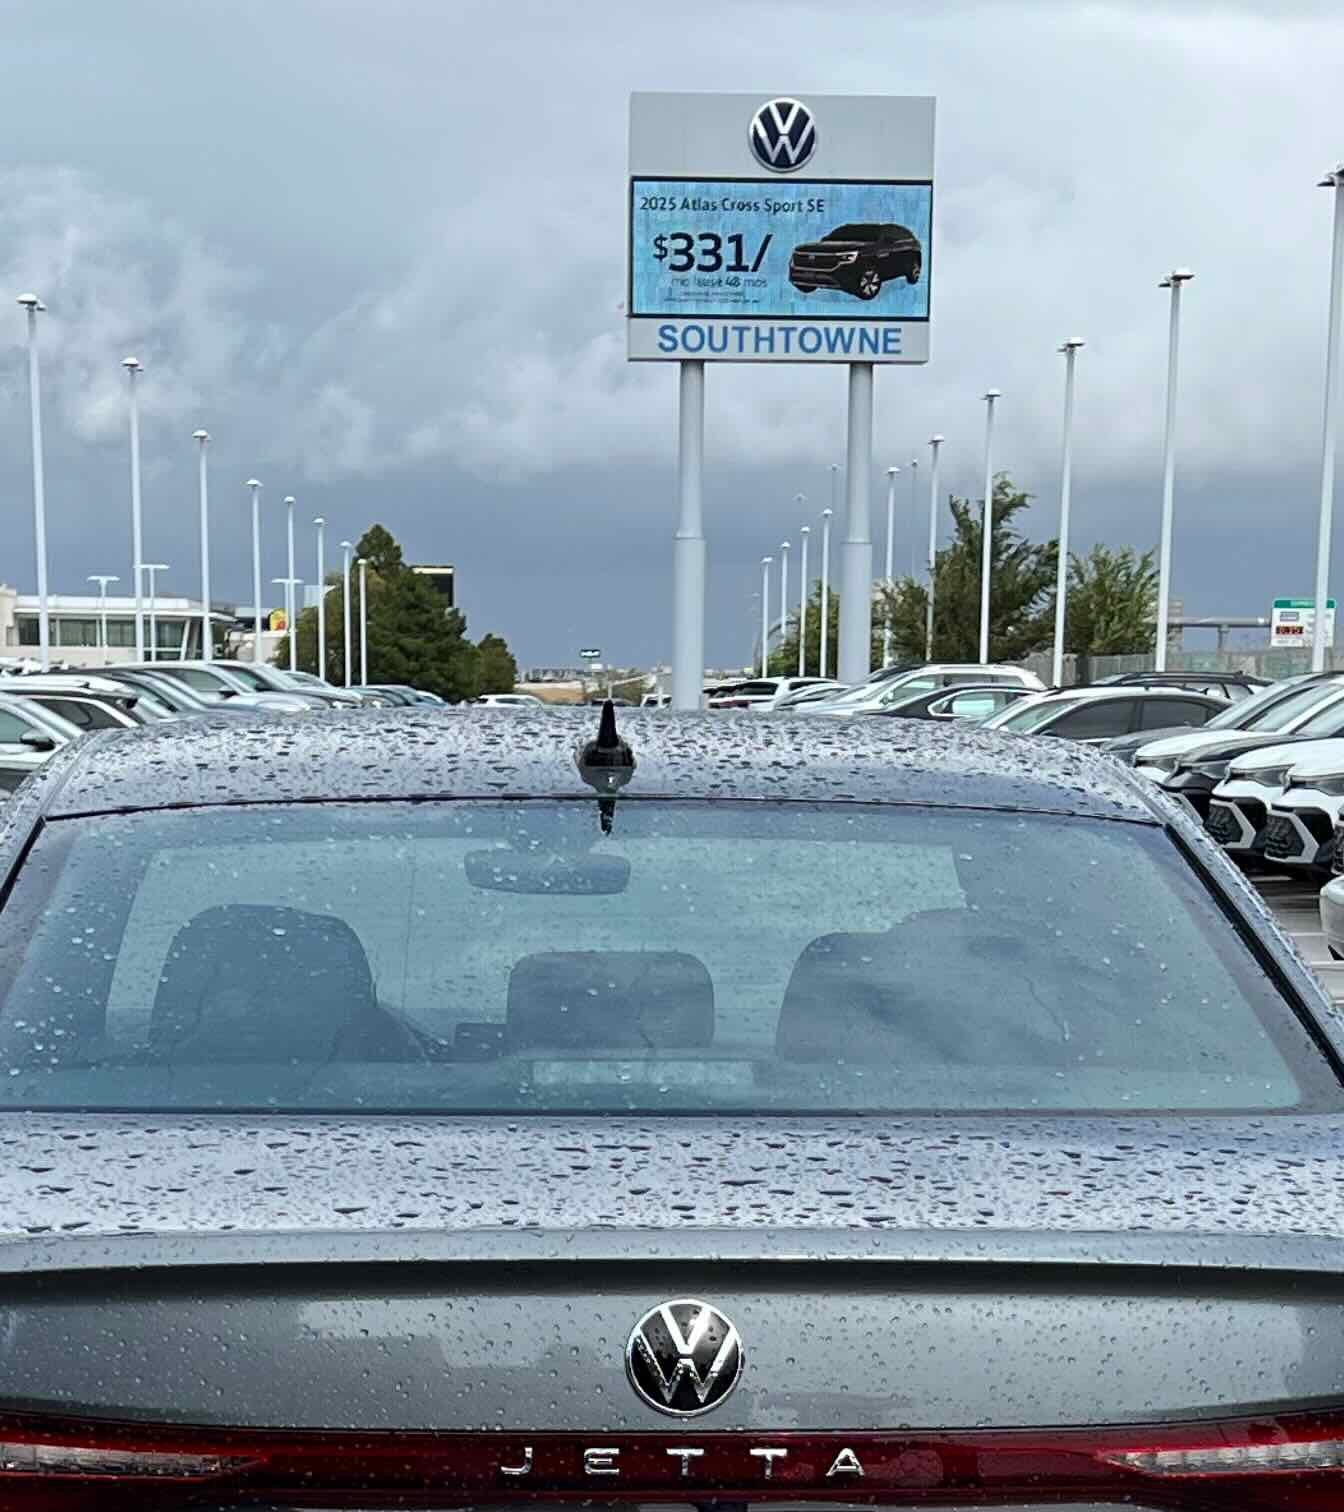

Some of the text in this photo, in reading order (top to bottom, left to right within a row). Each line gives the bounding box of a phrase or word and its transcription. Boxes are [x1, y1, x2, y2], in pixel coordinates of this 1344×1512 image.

[639, 196, 825, 215] 2025 Atlas Cross Sport SE
[658, 323, 903, 355] SOUTHTOWNE
[500, 1446, 866, 1479] JETTA
